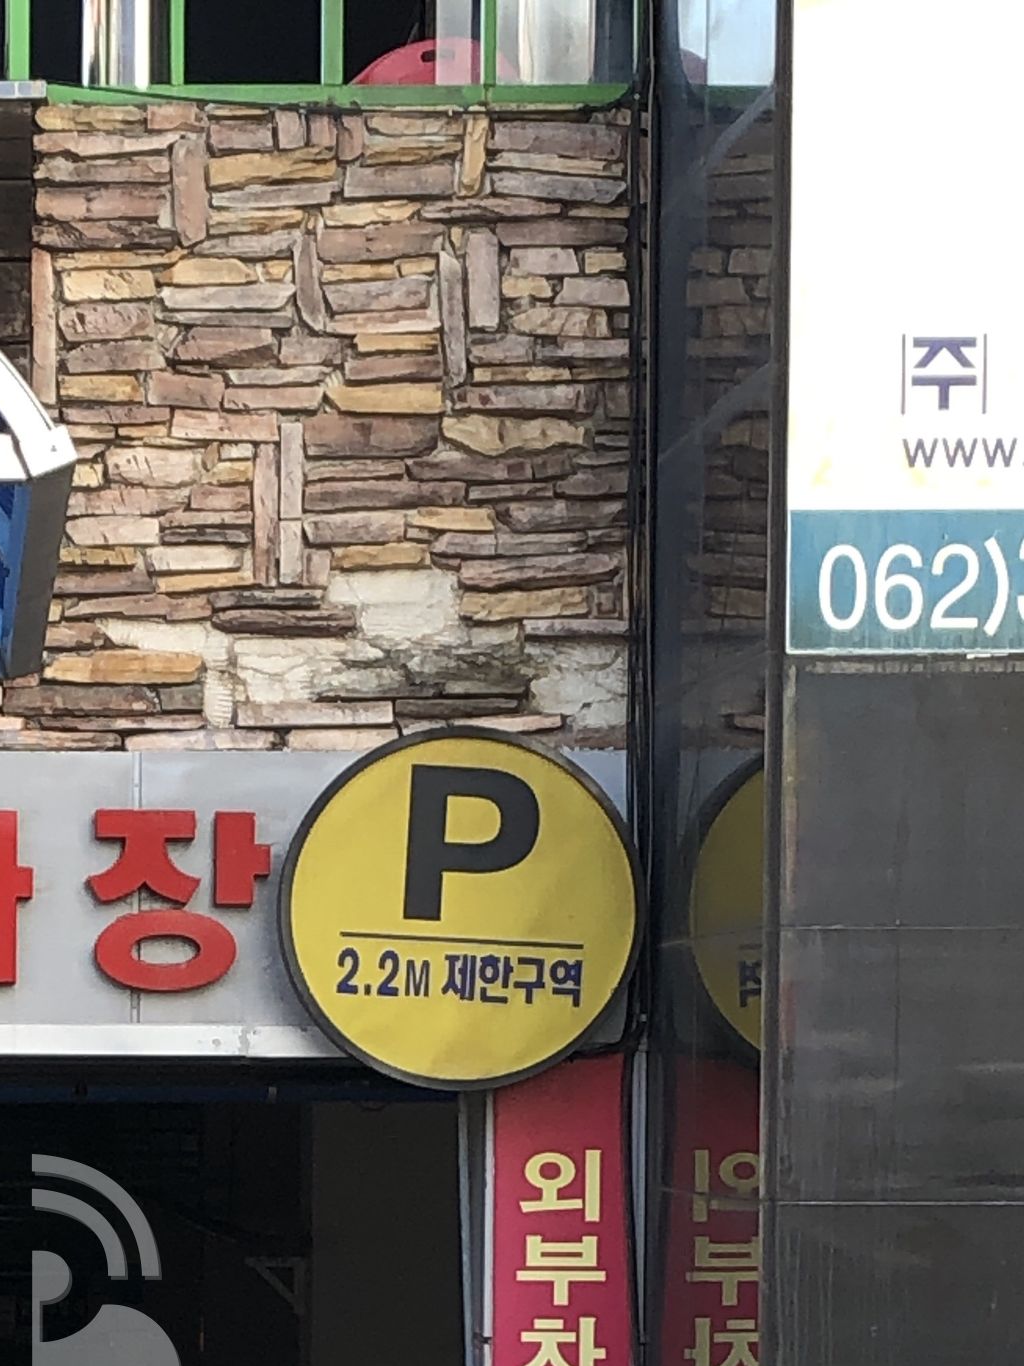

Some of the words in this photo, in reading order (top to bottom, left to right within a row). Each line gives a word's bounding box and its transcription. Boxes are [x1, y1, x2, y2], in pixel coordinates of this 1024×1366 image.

[818, 536, 1024, 636] 062)
[403, 763, 540, 921] P
[336, 947, 431, 998] 2.2M
[441, 953, 584, 1008] 제한구역
